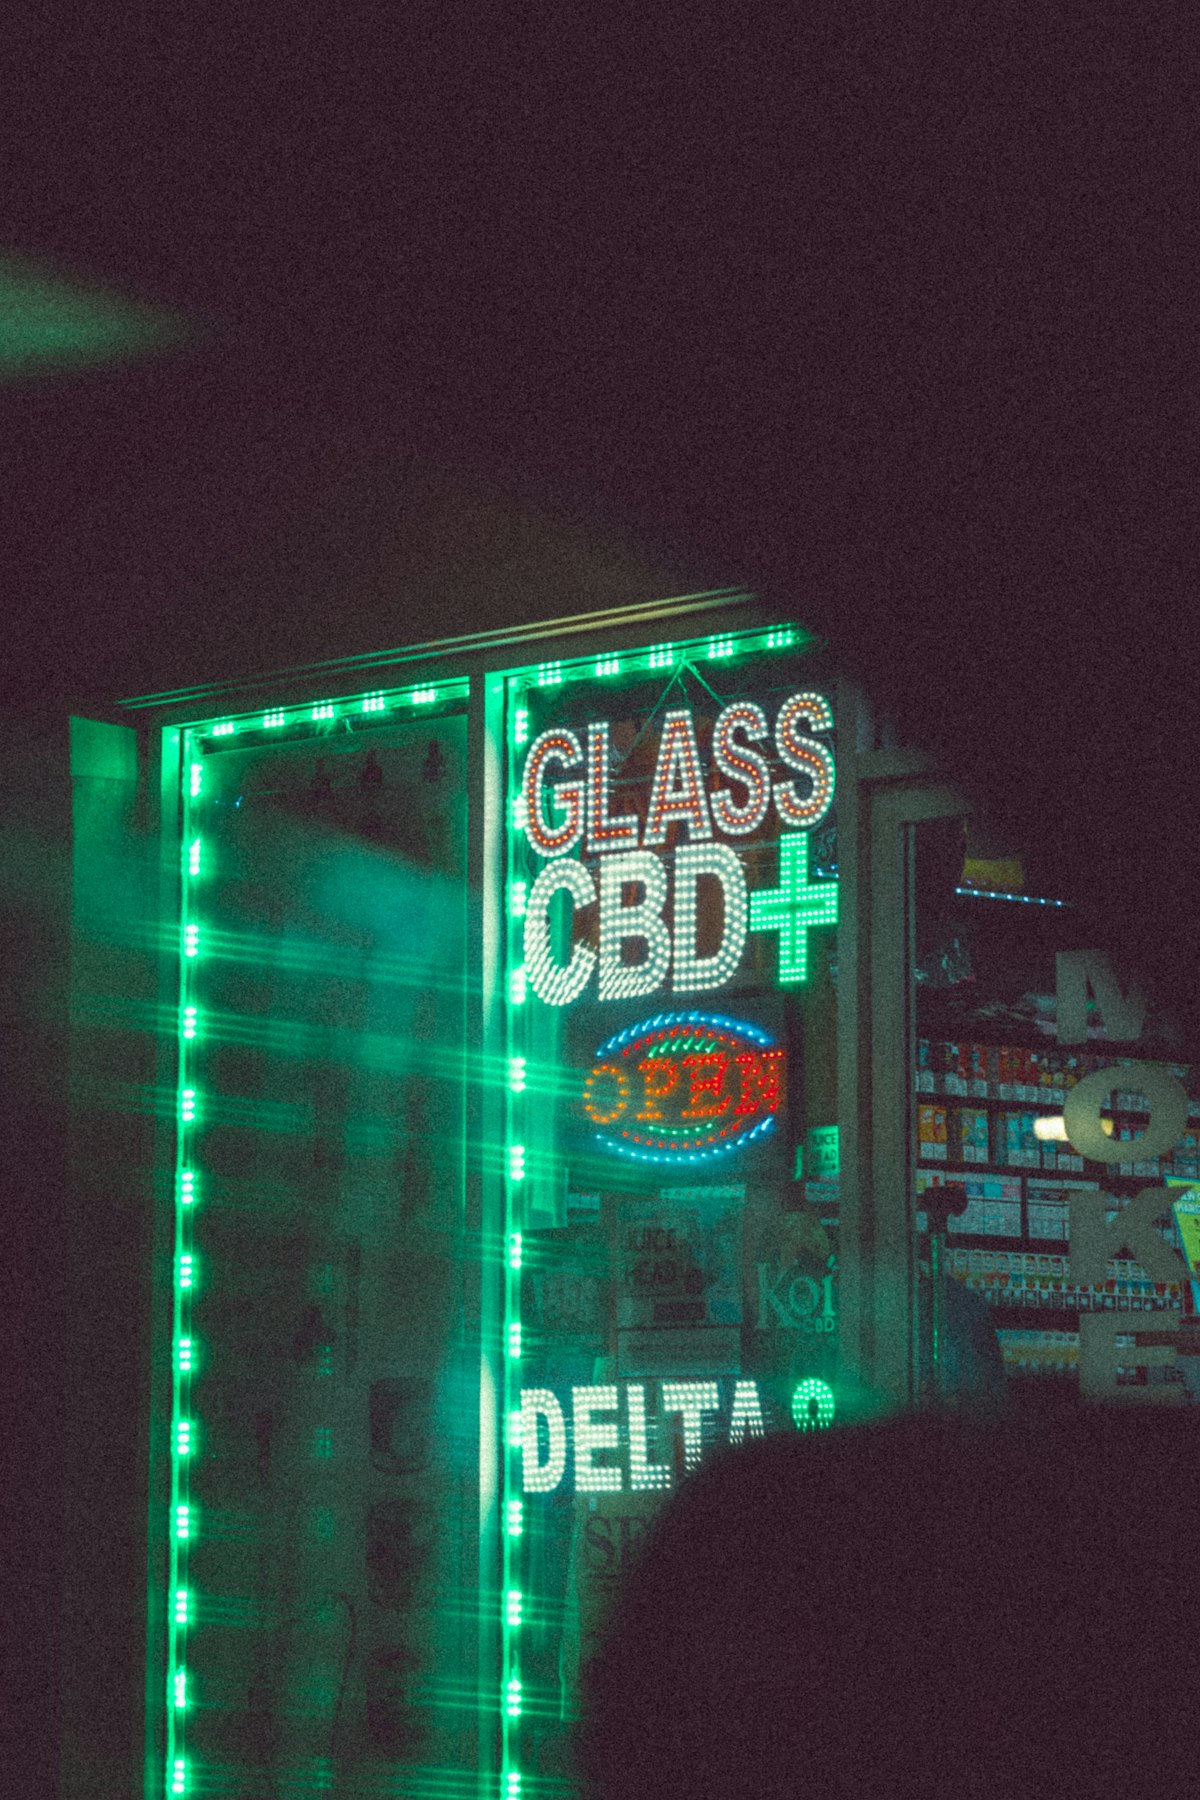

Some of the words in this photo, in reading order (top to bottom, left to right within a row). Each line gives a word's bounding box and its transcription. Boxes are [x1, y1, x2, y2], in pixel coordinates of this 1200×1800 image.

[522, 692, 836, 857] GLASS
[582, 1050, 787, 1124] OPEN
[520, 1381, 765, 1492] DELTA
